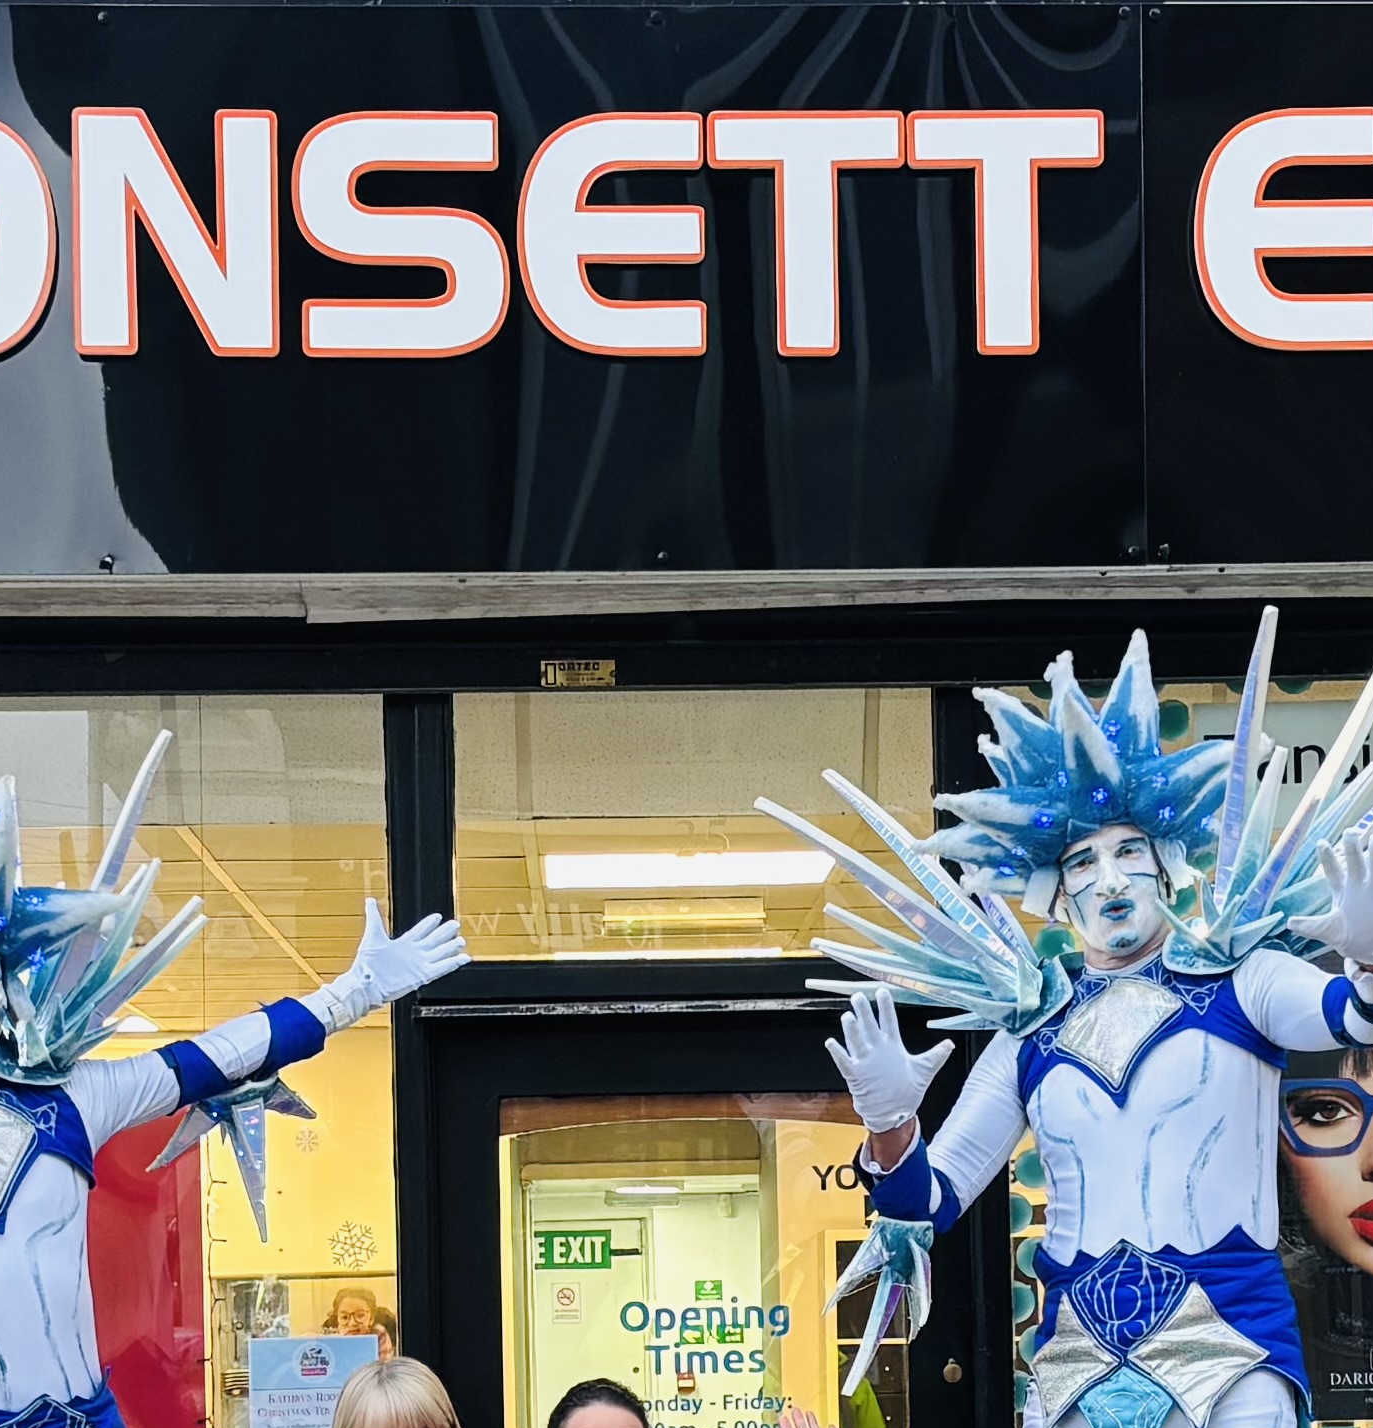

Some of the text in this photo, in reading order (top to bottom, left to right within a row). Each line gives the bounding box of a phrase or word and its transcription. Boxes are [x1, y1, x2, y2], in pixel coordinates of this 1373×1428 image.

[553, 1236, 606, 1265] EXIT
[620, 1296, 792, 1338] Opening
[645, 1343, 766, 1375] Times
[643, 1394, 703, 1415] onday
[723, 1393, 793, 1413] Friday:
